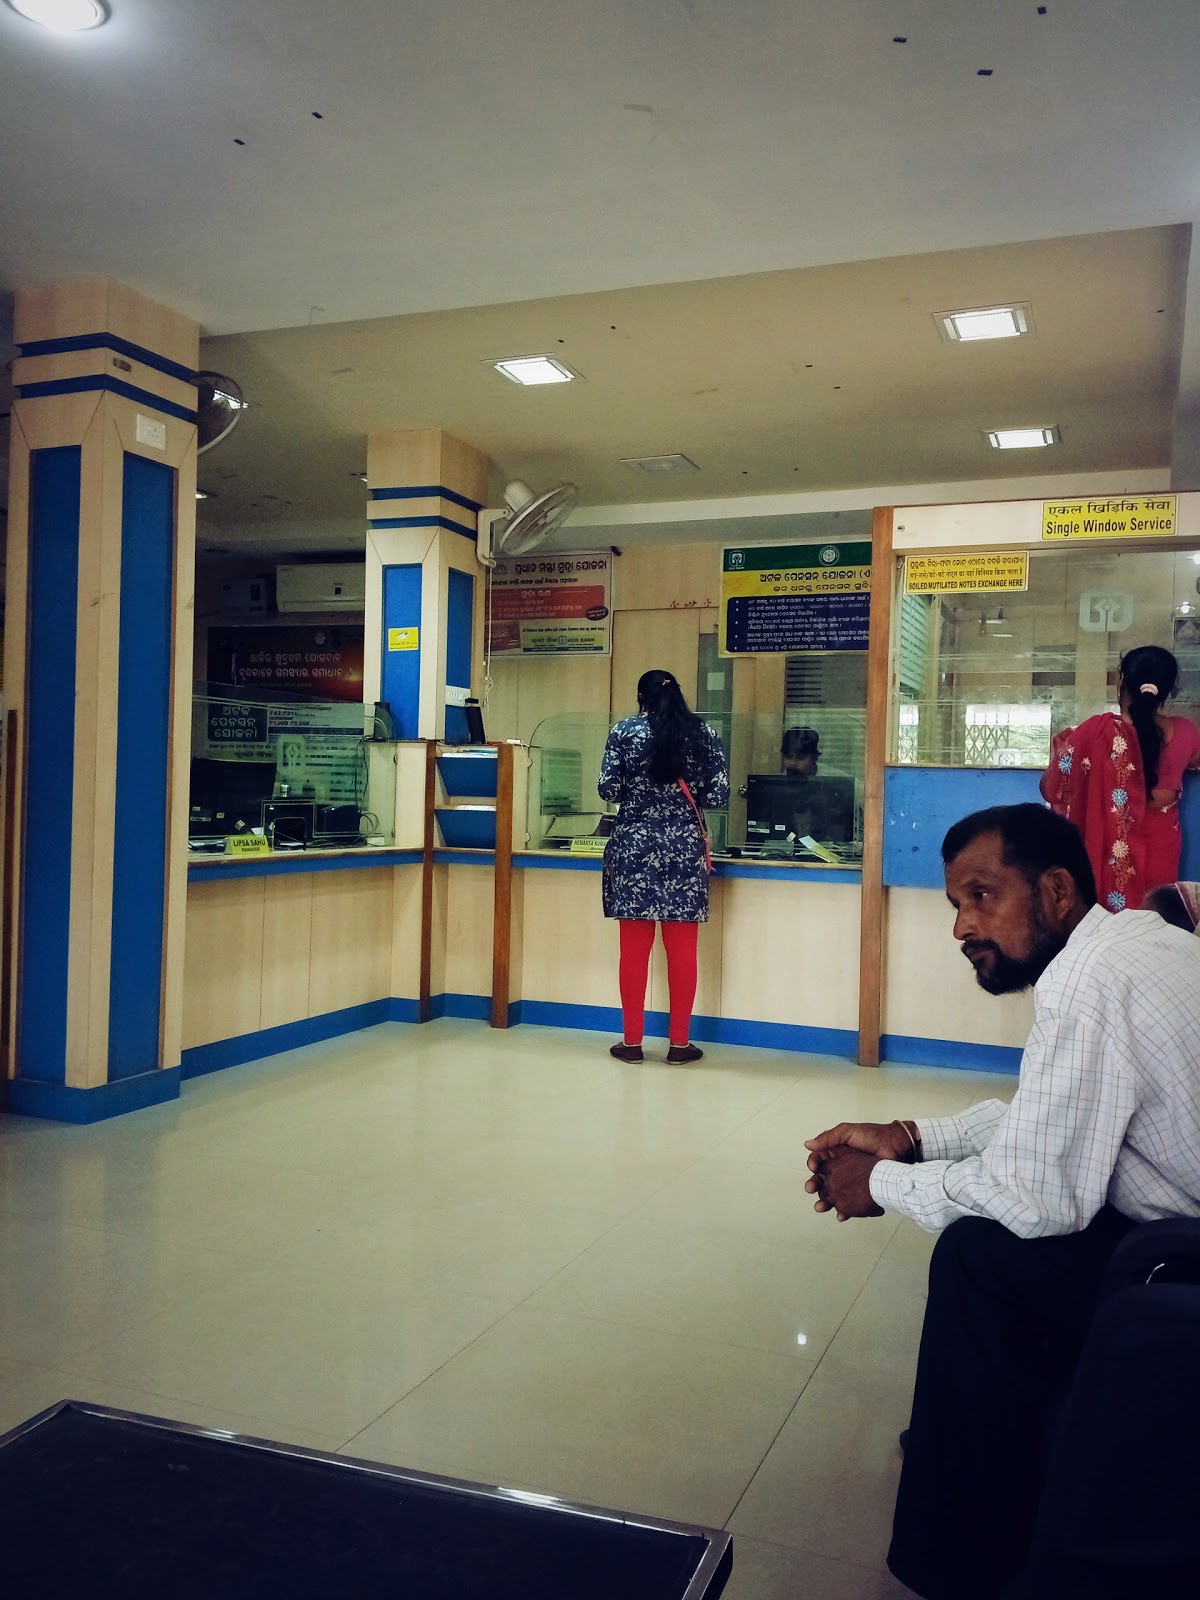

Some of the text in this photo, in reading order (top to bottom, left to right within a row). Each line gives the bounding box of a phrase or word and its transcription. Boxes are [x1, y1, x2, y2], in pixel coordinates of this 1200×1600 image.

[1048, 504, 1082, 518] एकल
[1144, 498, 1171, 510] सेवा
[1046, 517, 1172, 536] Single Window Service
[576, 560, 606, 571] ଯୋଜନା
[760, 573, 781, 582] ଅଟଳ
[822, 570, 856, 579] ଯୋଜନା
[909, 582, 927, 590] SOILED
[928, 580, 957, 589] MUTILATED
[978, 579, 1007, 587] EXCHANGE
[214, 728, 257, 738] ଯୋଜନା
